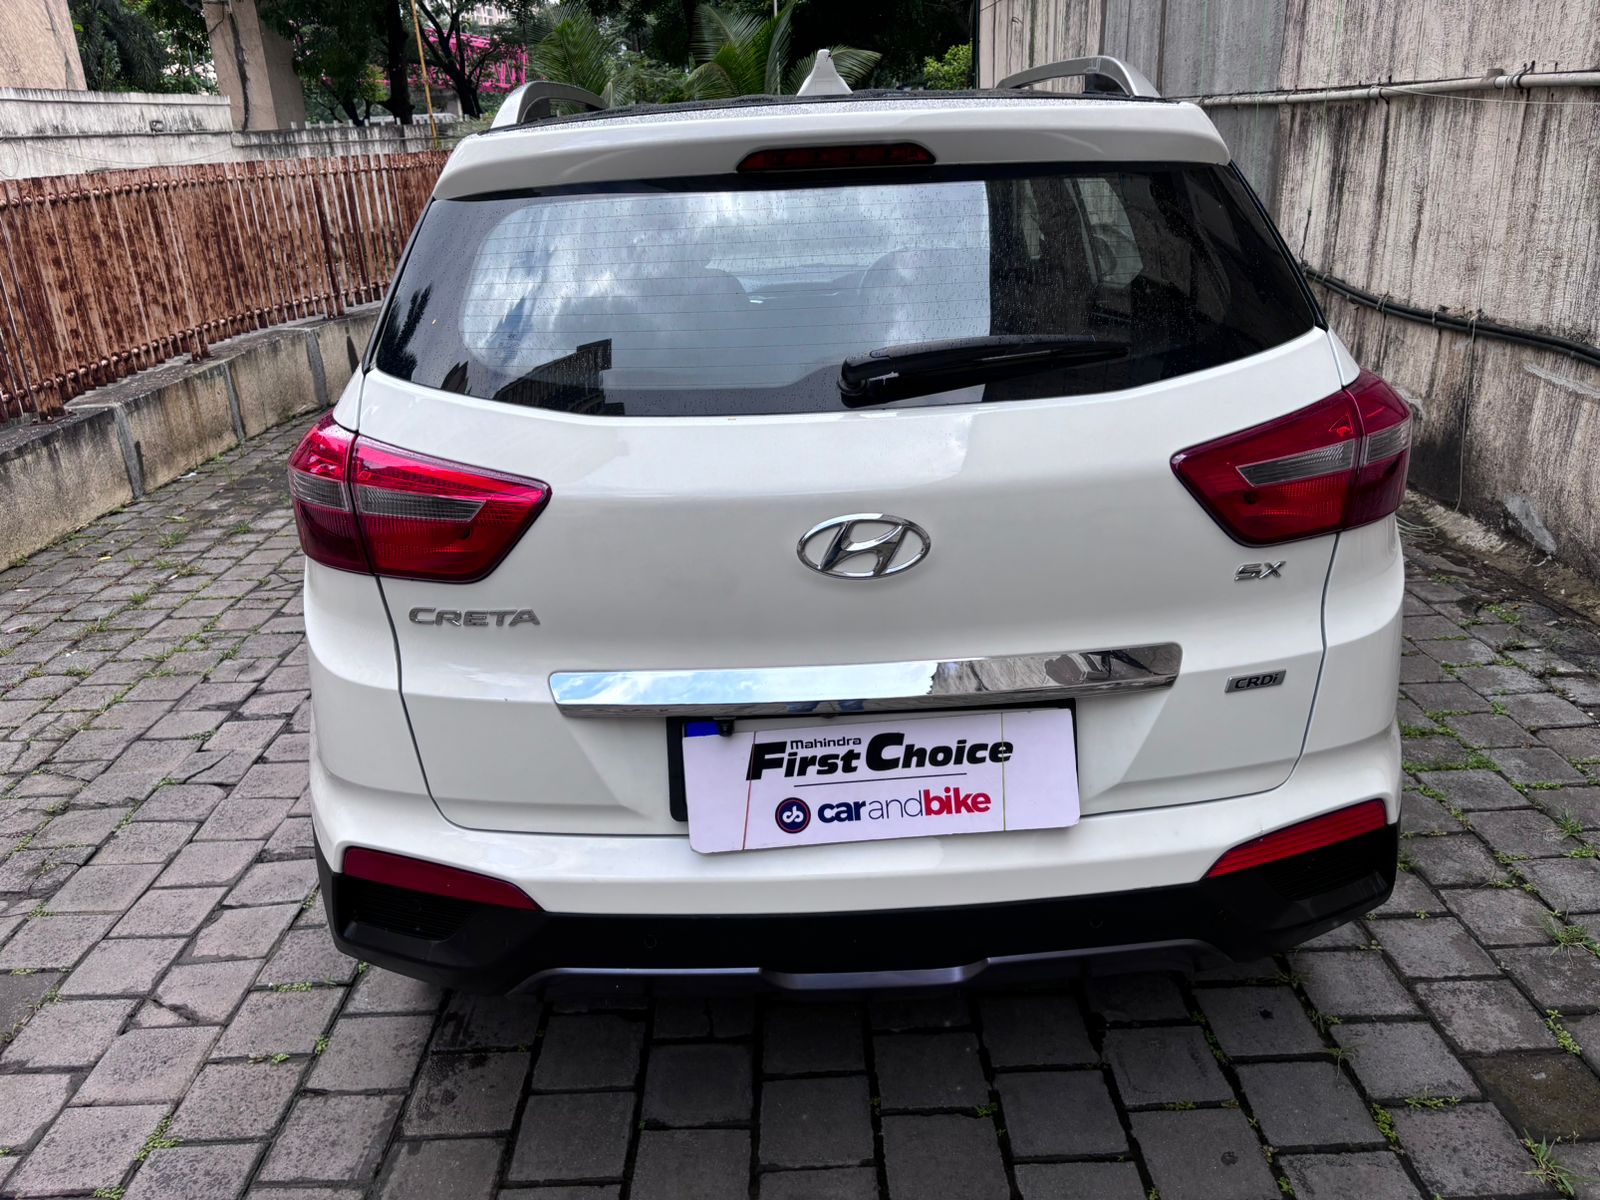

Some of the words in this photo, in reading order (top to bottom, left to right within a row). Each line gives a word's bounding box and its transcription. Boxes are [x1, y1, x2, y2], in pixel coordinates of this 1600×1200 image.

[1234, 560, 1286, 581] SX
[408, 607, 541, 627] CRETA
[1235, 673, 1279, 689] CRDi
[790, 736, 862, 751] Mahindra
[746, 741, 862, 781] First
[865, 732, 1014, 772] Choice
[817, 787, 992, 823] carandbike
